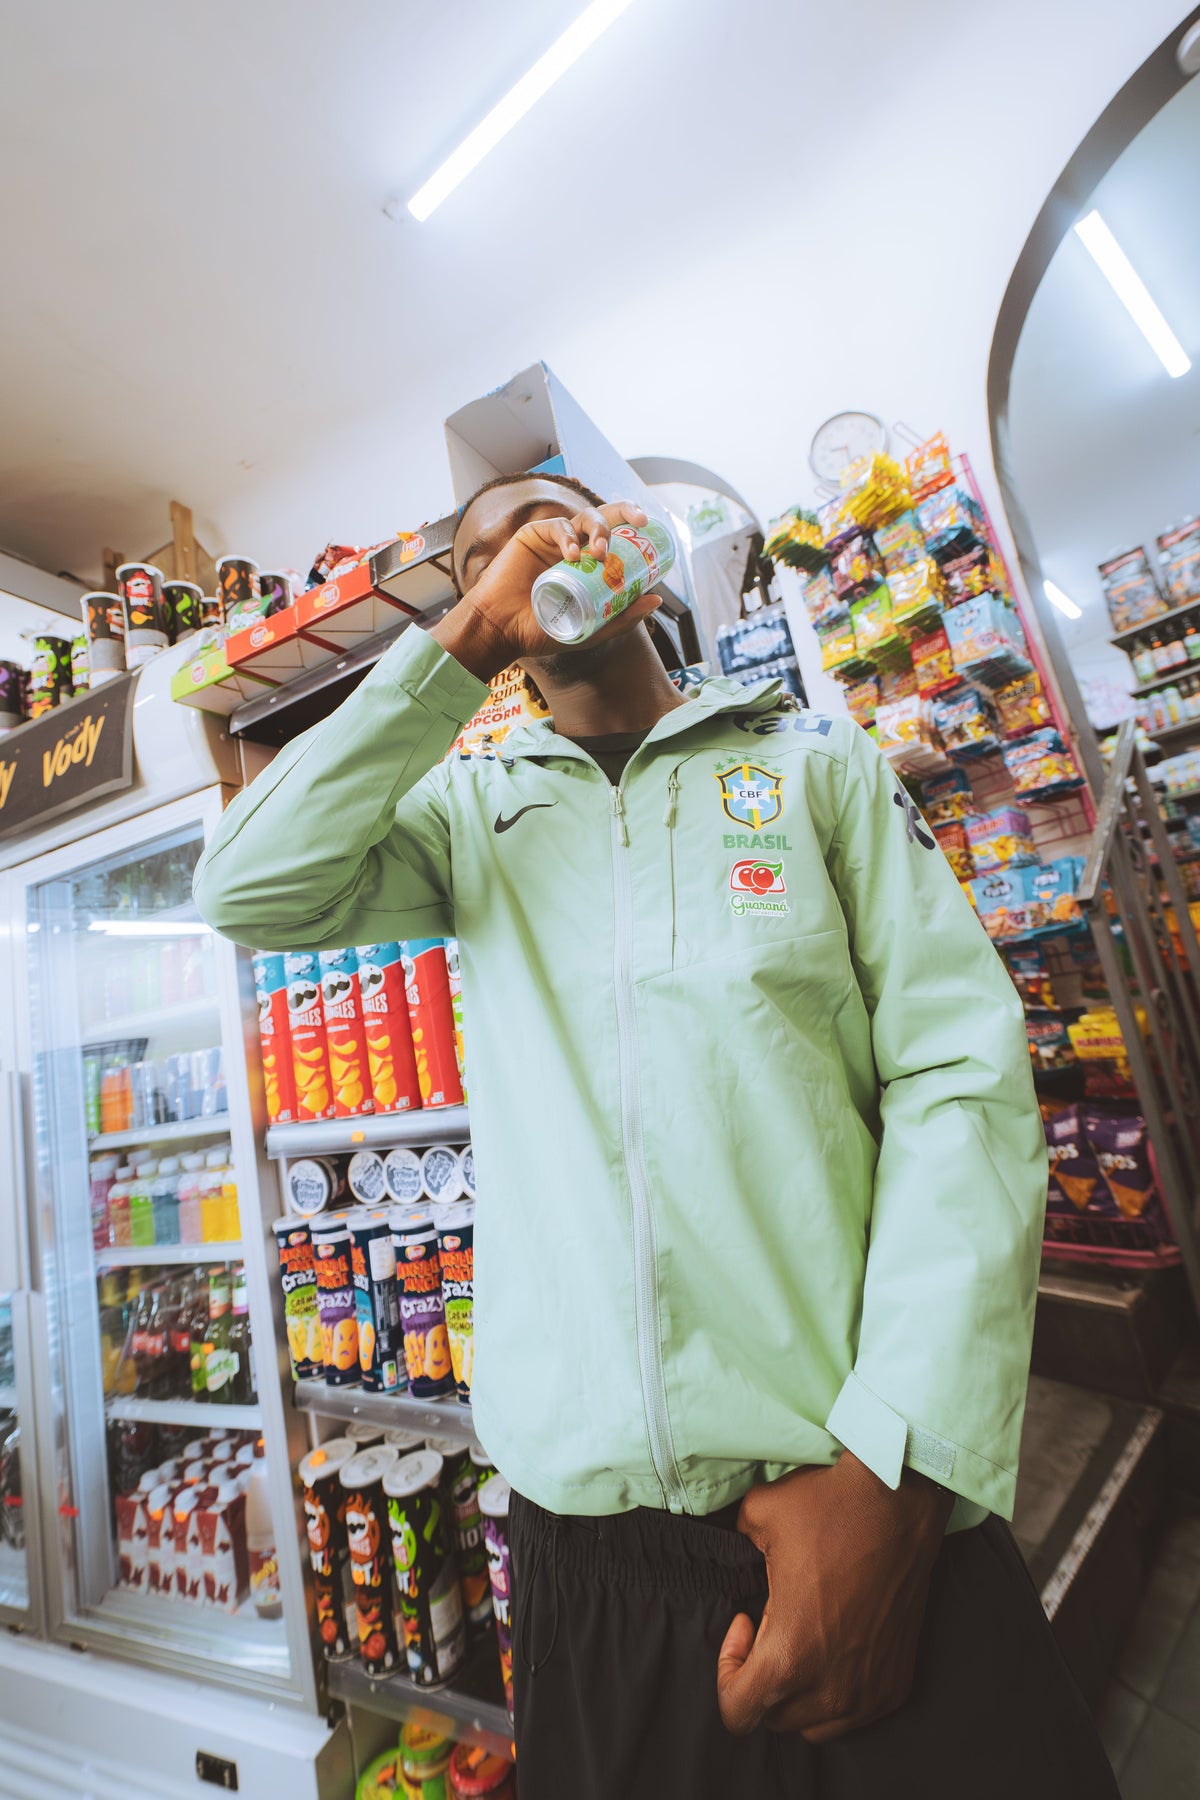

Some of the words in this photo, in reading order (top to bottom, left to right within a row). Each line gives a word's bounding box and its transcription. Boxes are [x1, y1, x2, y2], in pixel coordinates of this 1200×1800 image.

[43, 715, 105, 787] Vody
[739, 790, 764, 798] CBF
[722, 834, 793, 851] BRASIL
[730, 894, 789, 916] Guaraná
[400, 1296, 443, 1319] Crazy
